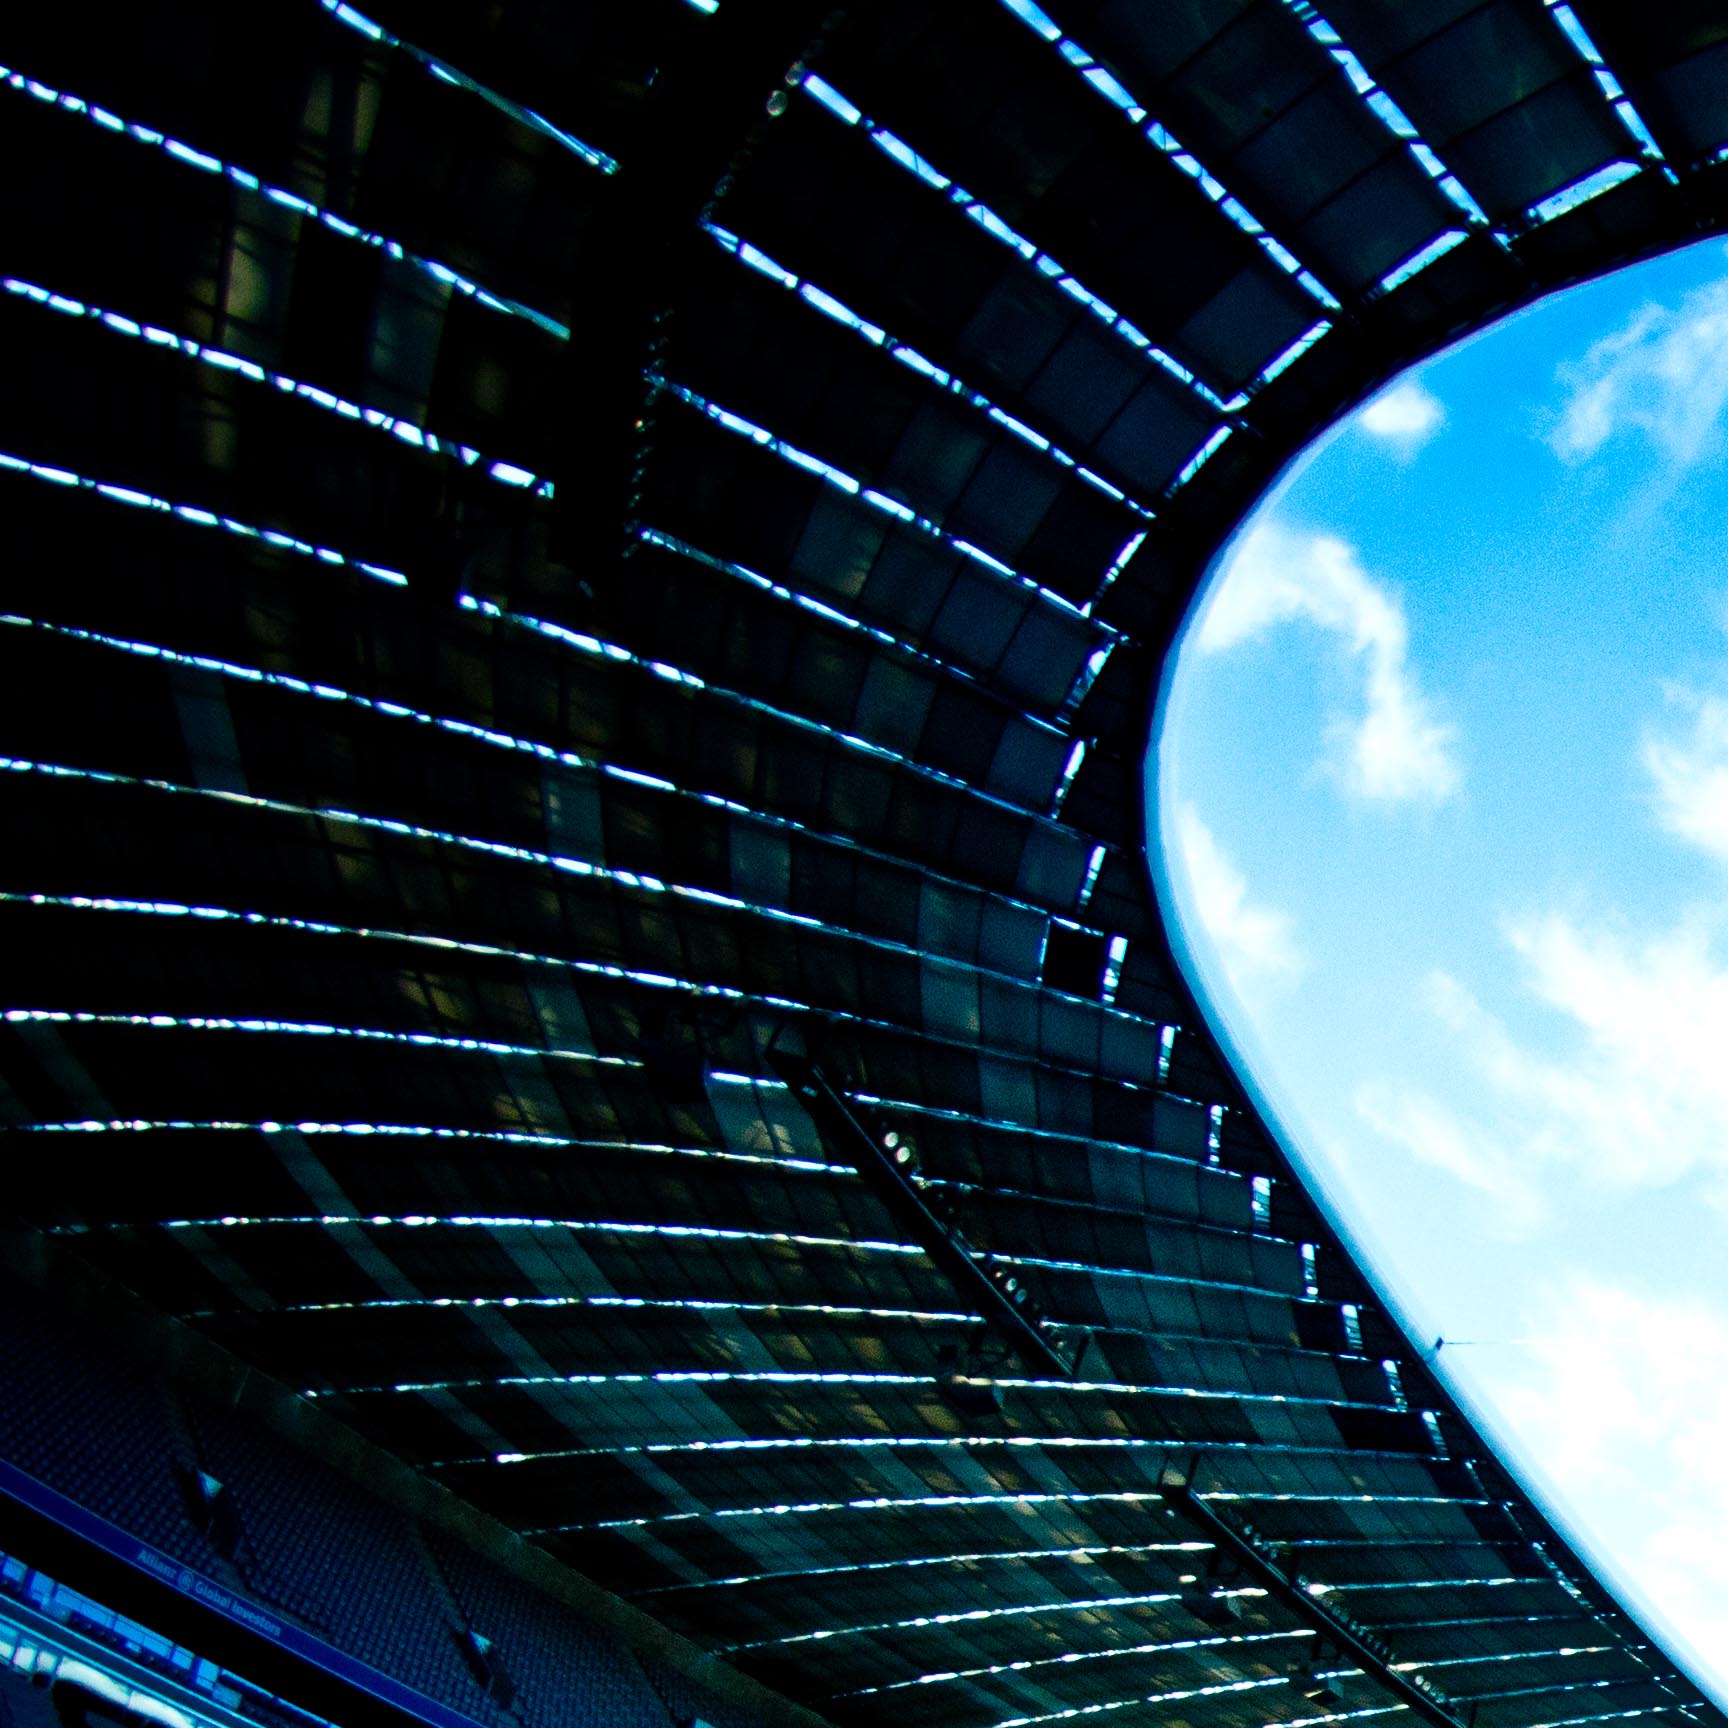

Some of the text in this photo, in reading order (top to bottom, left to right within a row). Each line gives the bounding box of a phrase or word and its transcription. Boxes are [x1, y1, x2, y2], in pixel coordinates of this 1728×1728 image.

[136, 1549, 282, 1637] Allianz Global Investors
